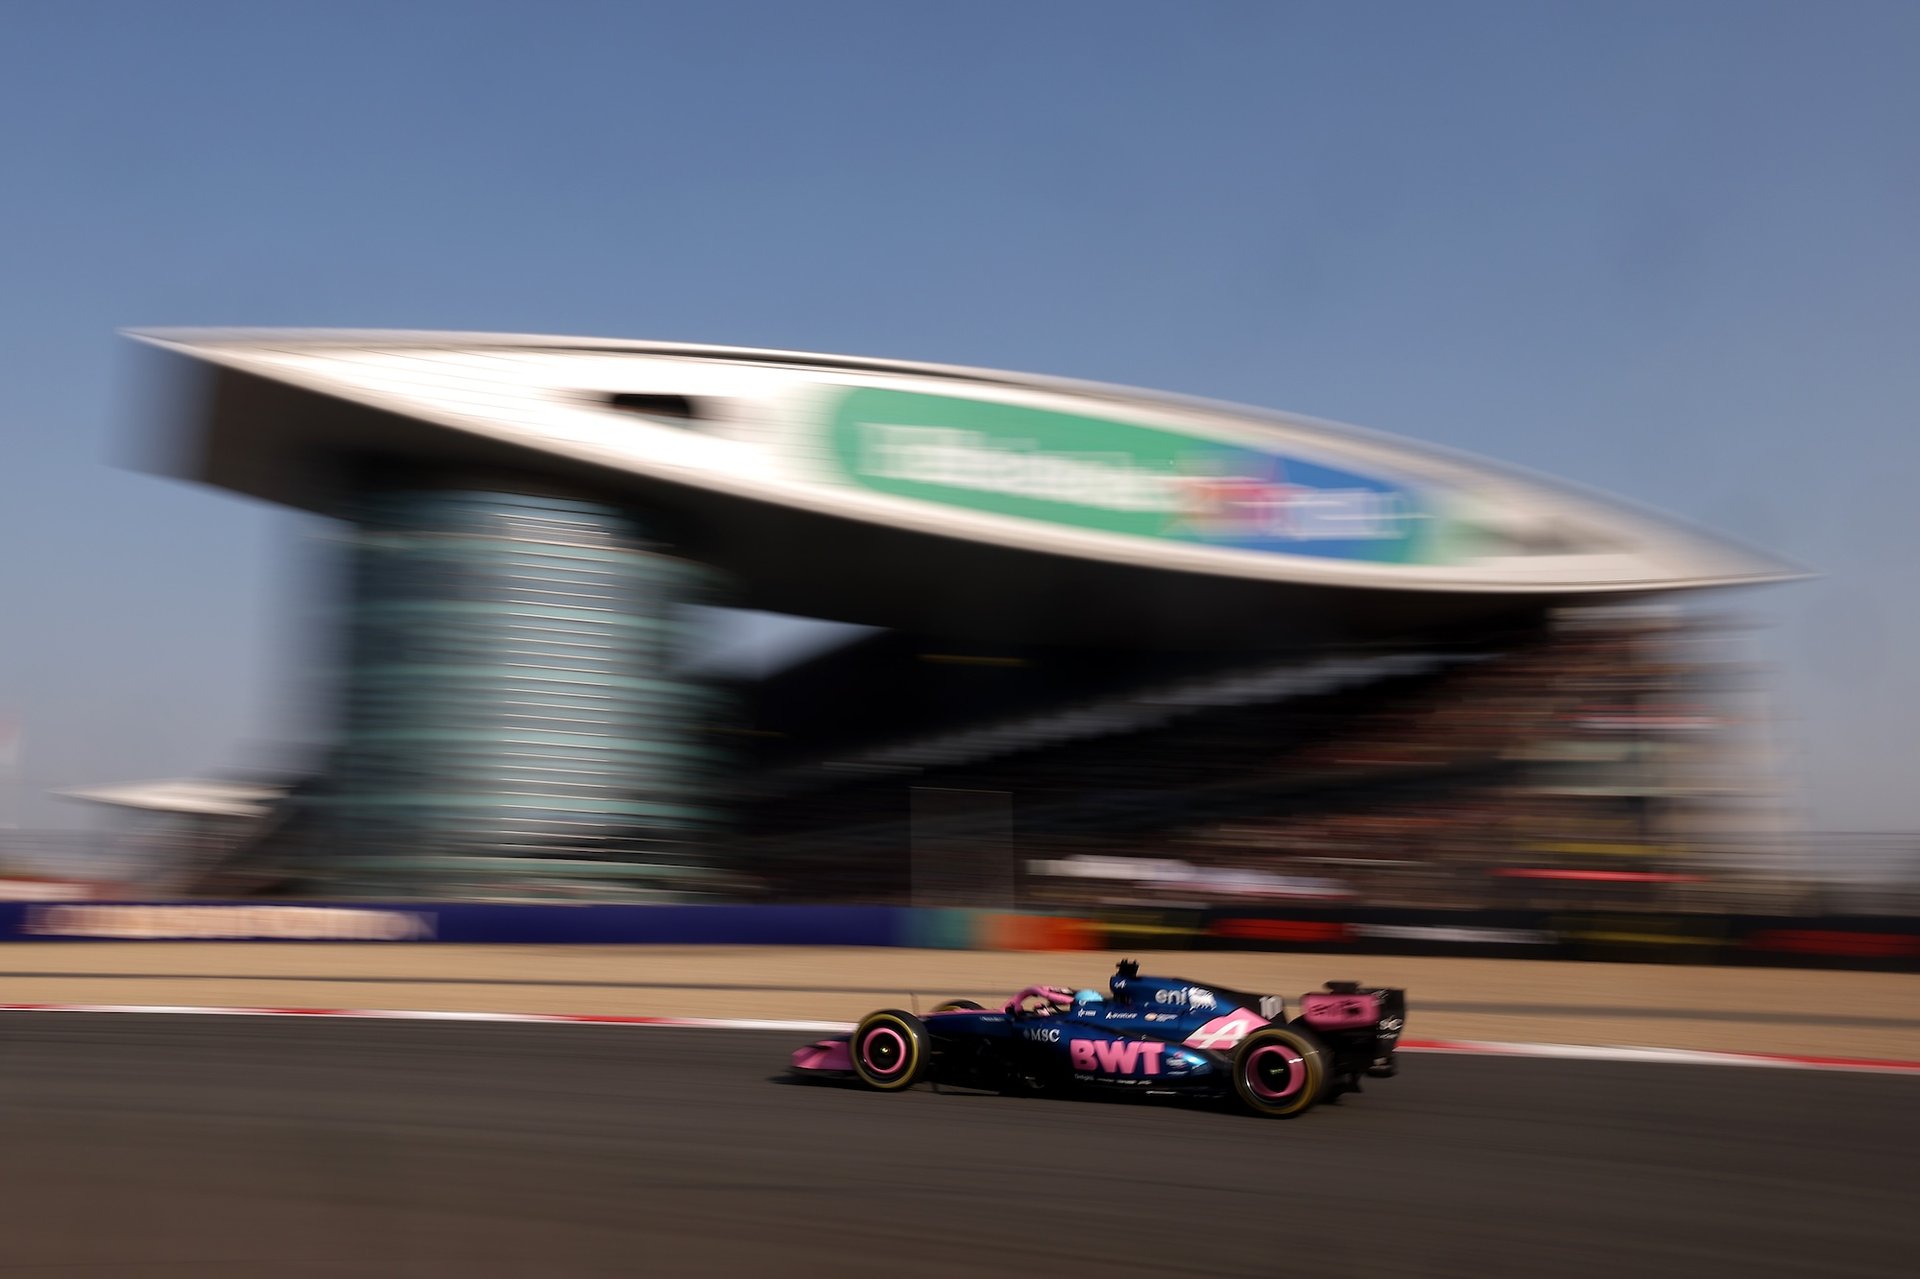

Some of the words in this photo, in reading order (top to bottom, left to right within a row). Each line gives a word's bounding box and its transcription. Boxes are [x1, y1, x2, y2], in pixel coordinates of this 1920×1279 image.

[1155, 987, 1188, 1005] eni
[1259, 995, 1283, 1020] 10
[1031, 1028, 1060, 1042] MSC
[1070, 1039, 1165, 1075] BWT
